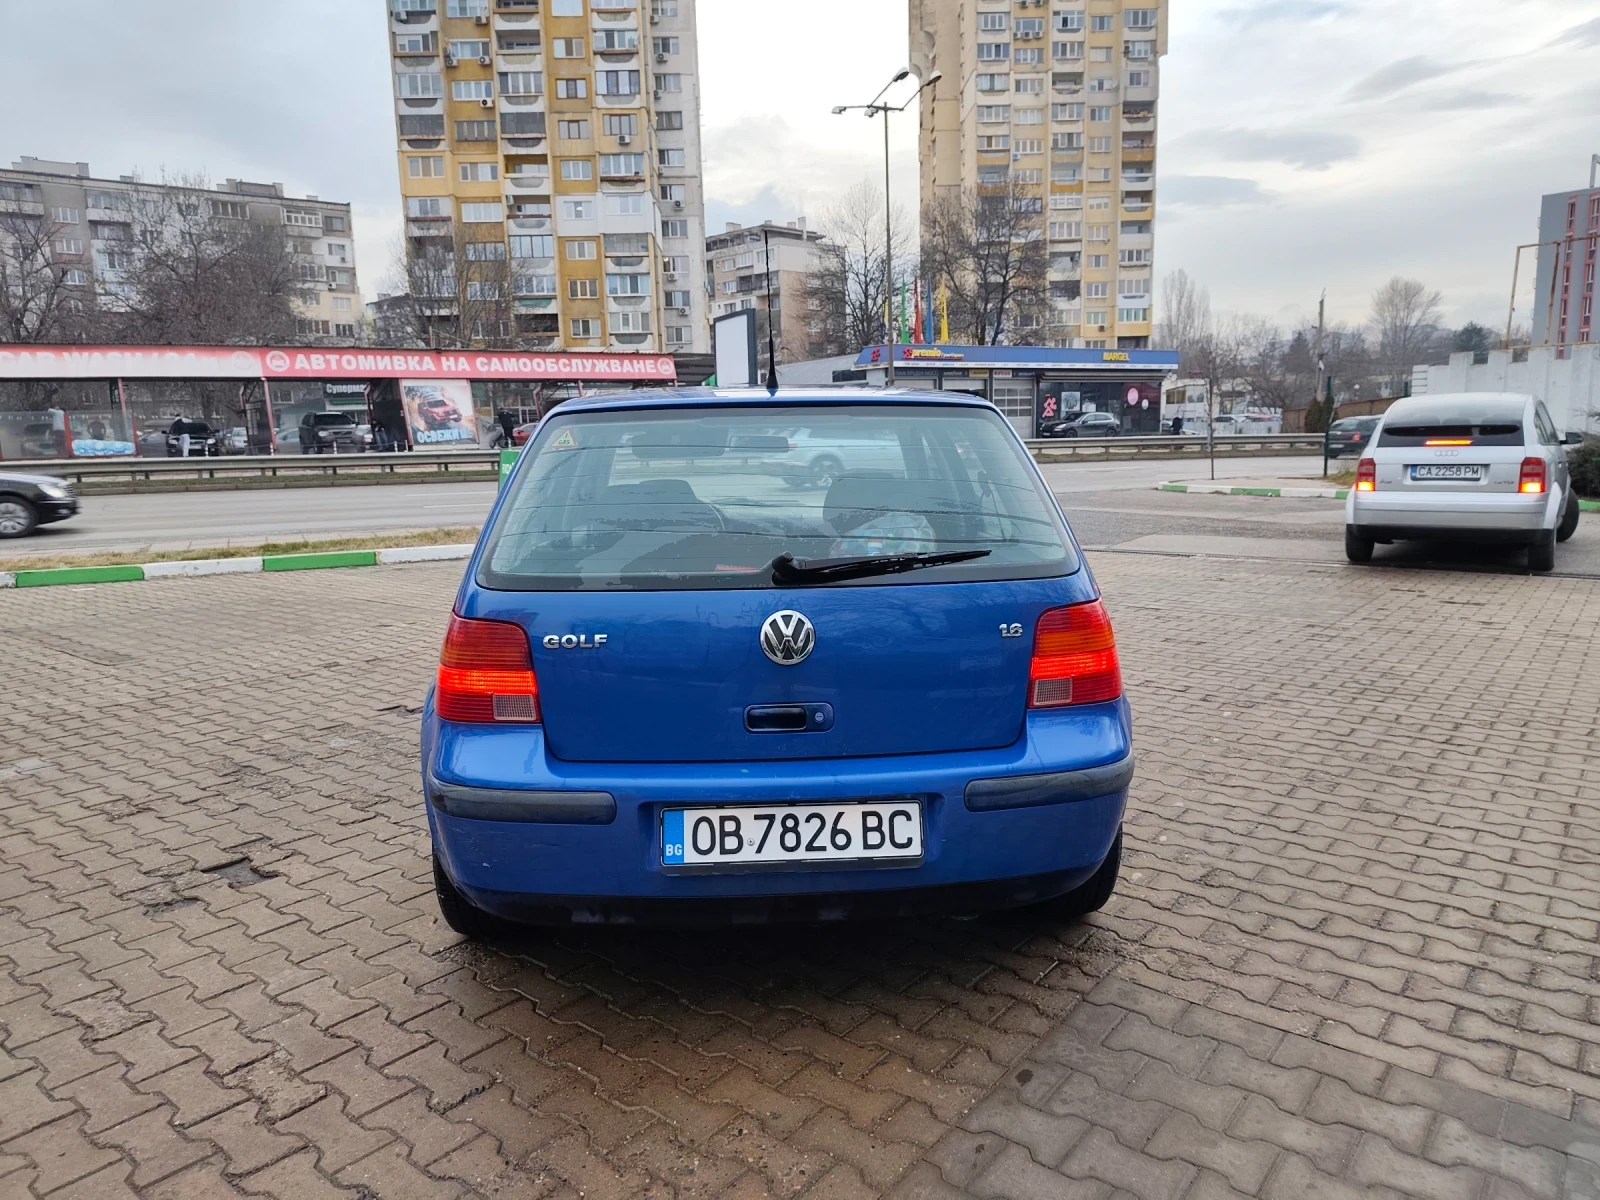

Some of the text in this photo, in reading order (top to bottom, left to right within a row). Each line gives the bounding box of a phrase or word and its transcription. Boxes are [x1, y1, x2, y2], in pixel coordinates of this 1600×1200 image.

[295, 354, 657, 374] АВТОМИВКА НА САМООБСЛУЖВАНЕ
[1418, 466, 1479, 476] CA 2258 PM
[543, 634, 608, 649] GOLF
[691, 809, 913, 856] OB 7826 BC
[665, 844, 683, 857] BG
